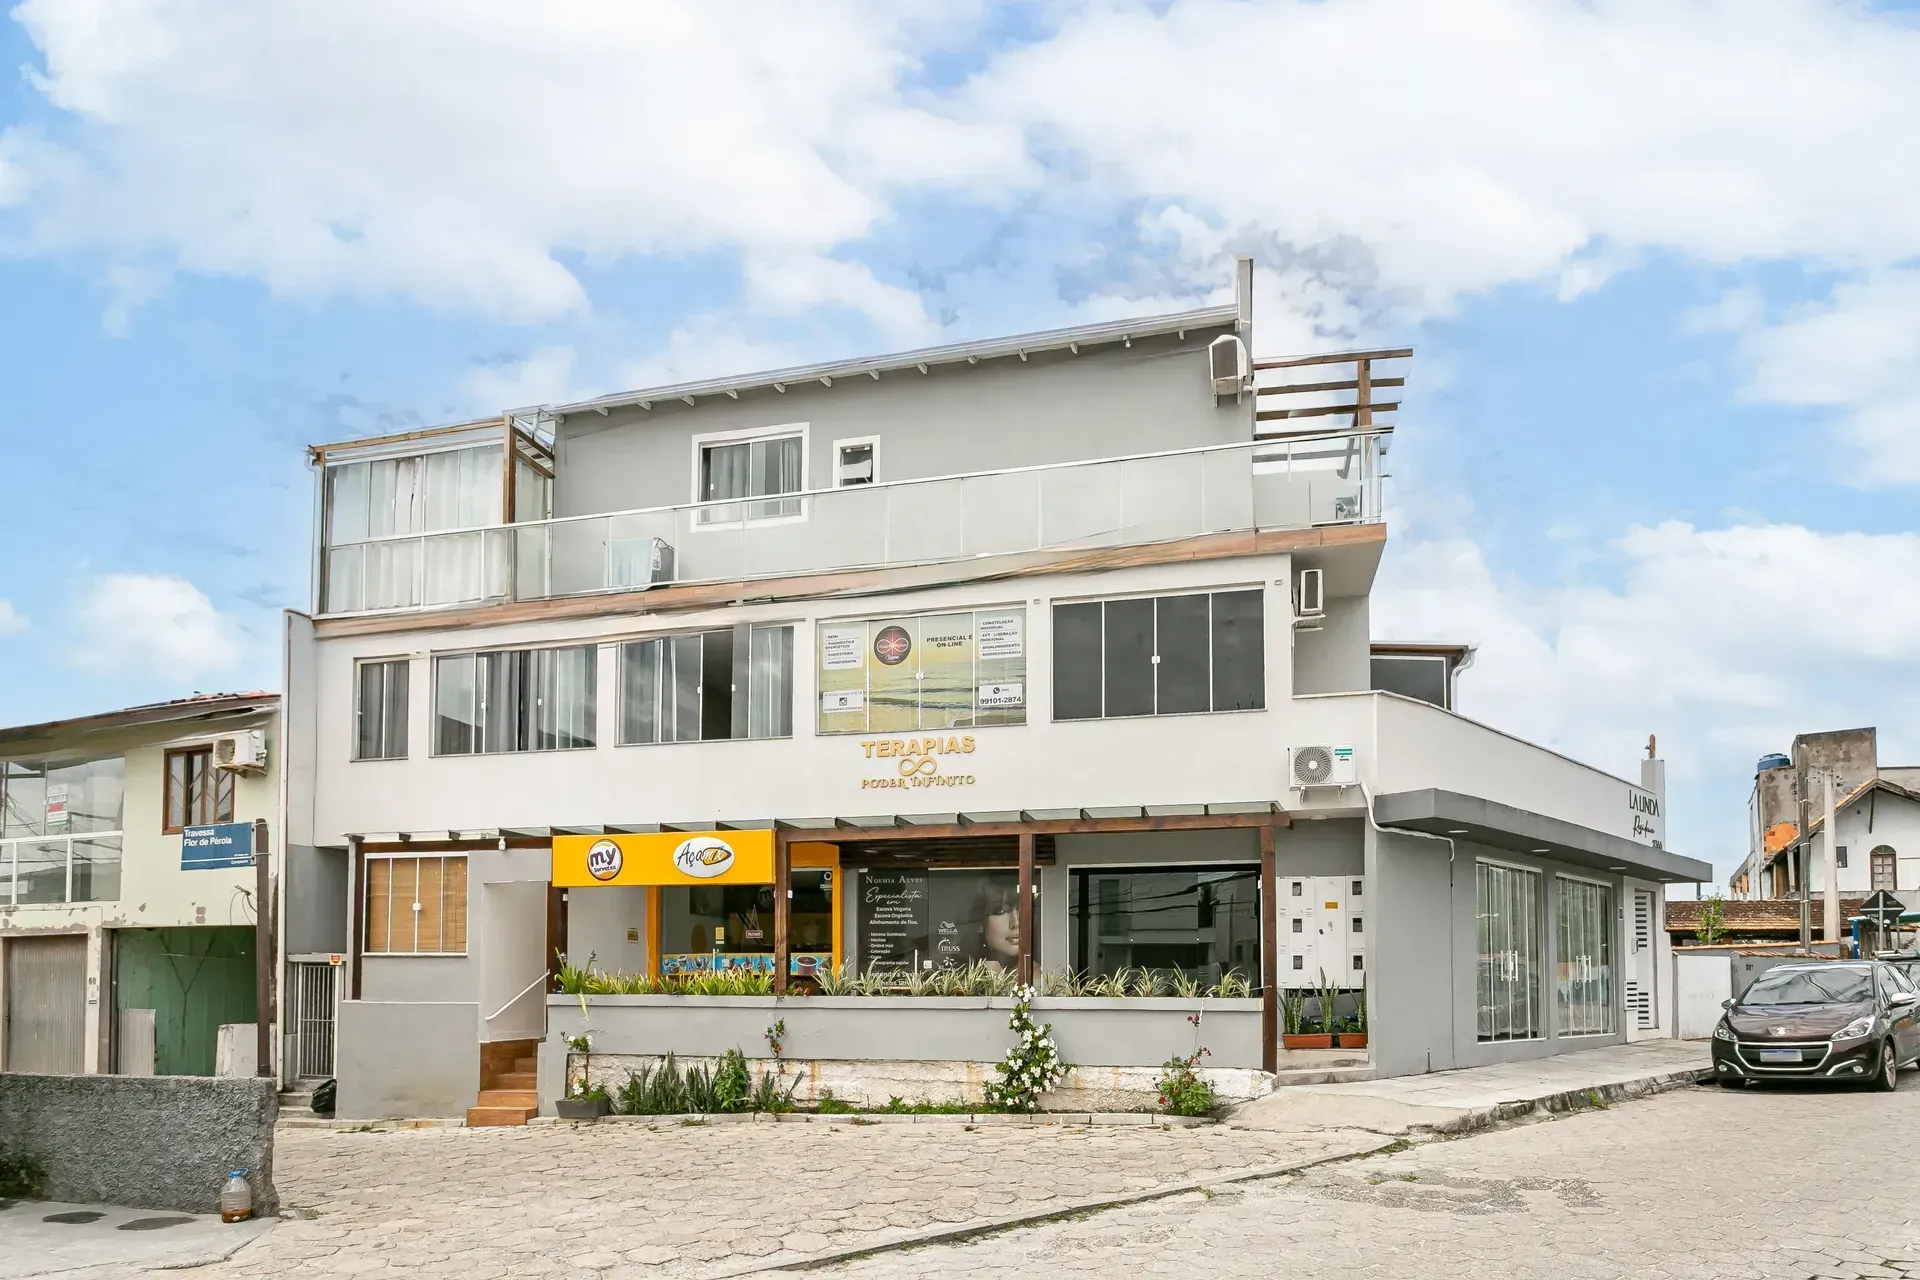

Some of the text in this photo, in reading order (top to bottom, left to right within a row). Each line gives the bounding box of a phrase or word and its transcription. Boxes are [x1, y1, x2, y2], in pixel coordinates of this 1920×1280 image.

[926, 635, 967, 643] PRESENCIAL
[936, 640, 963, 648] ON-LINE
[980, 696, 1022, 705] 99101-2874
[861, 736, 975, 757] TERAPIAS
[862, 775, 976, 789] PODER INFINITO
[184, 829, 214, 837] Travessa
[184, 836, 232, 847] Flor de Pérola
[590, 847, 617, 867] my
[865, 886, 922, 903] Especialista
